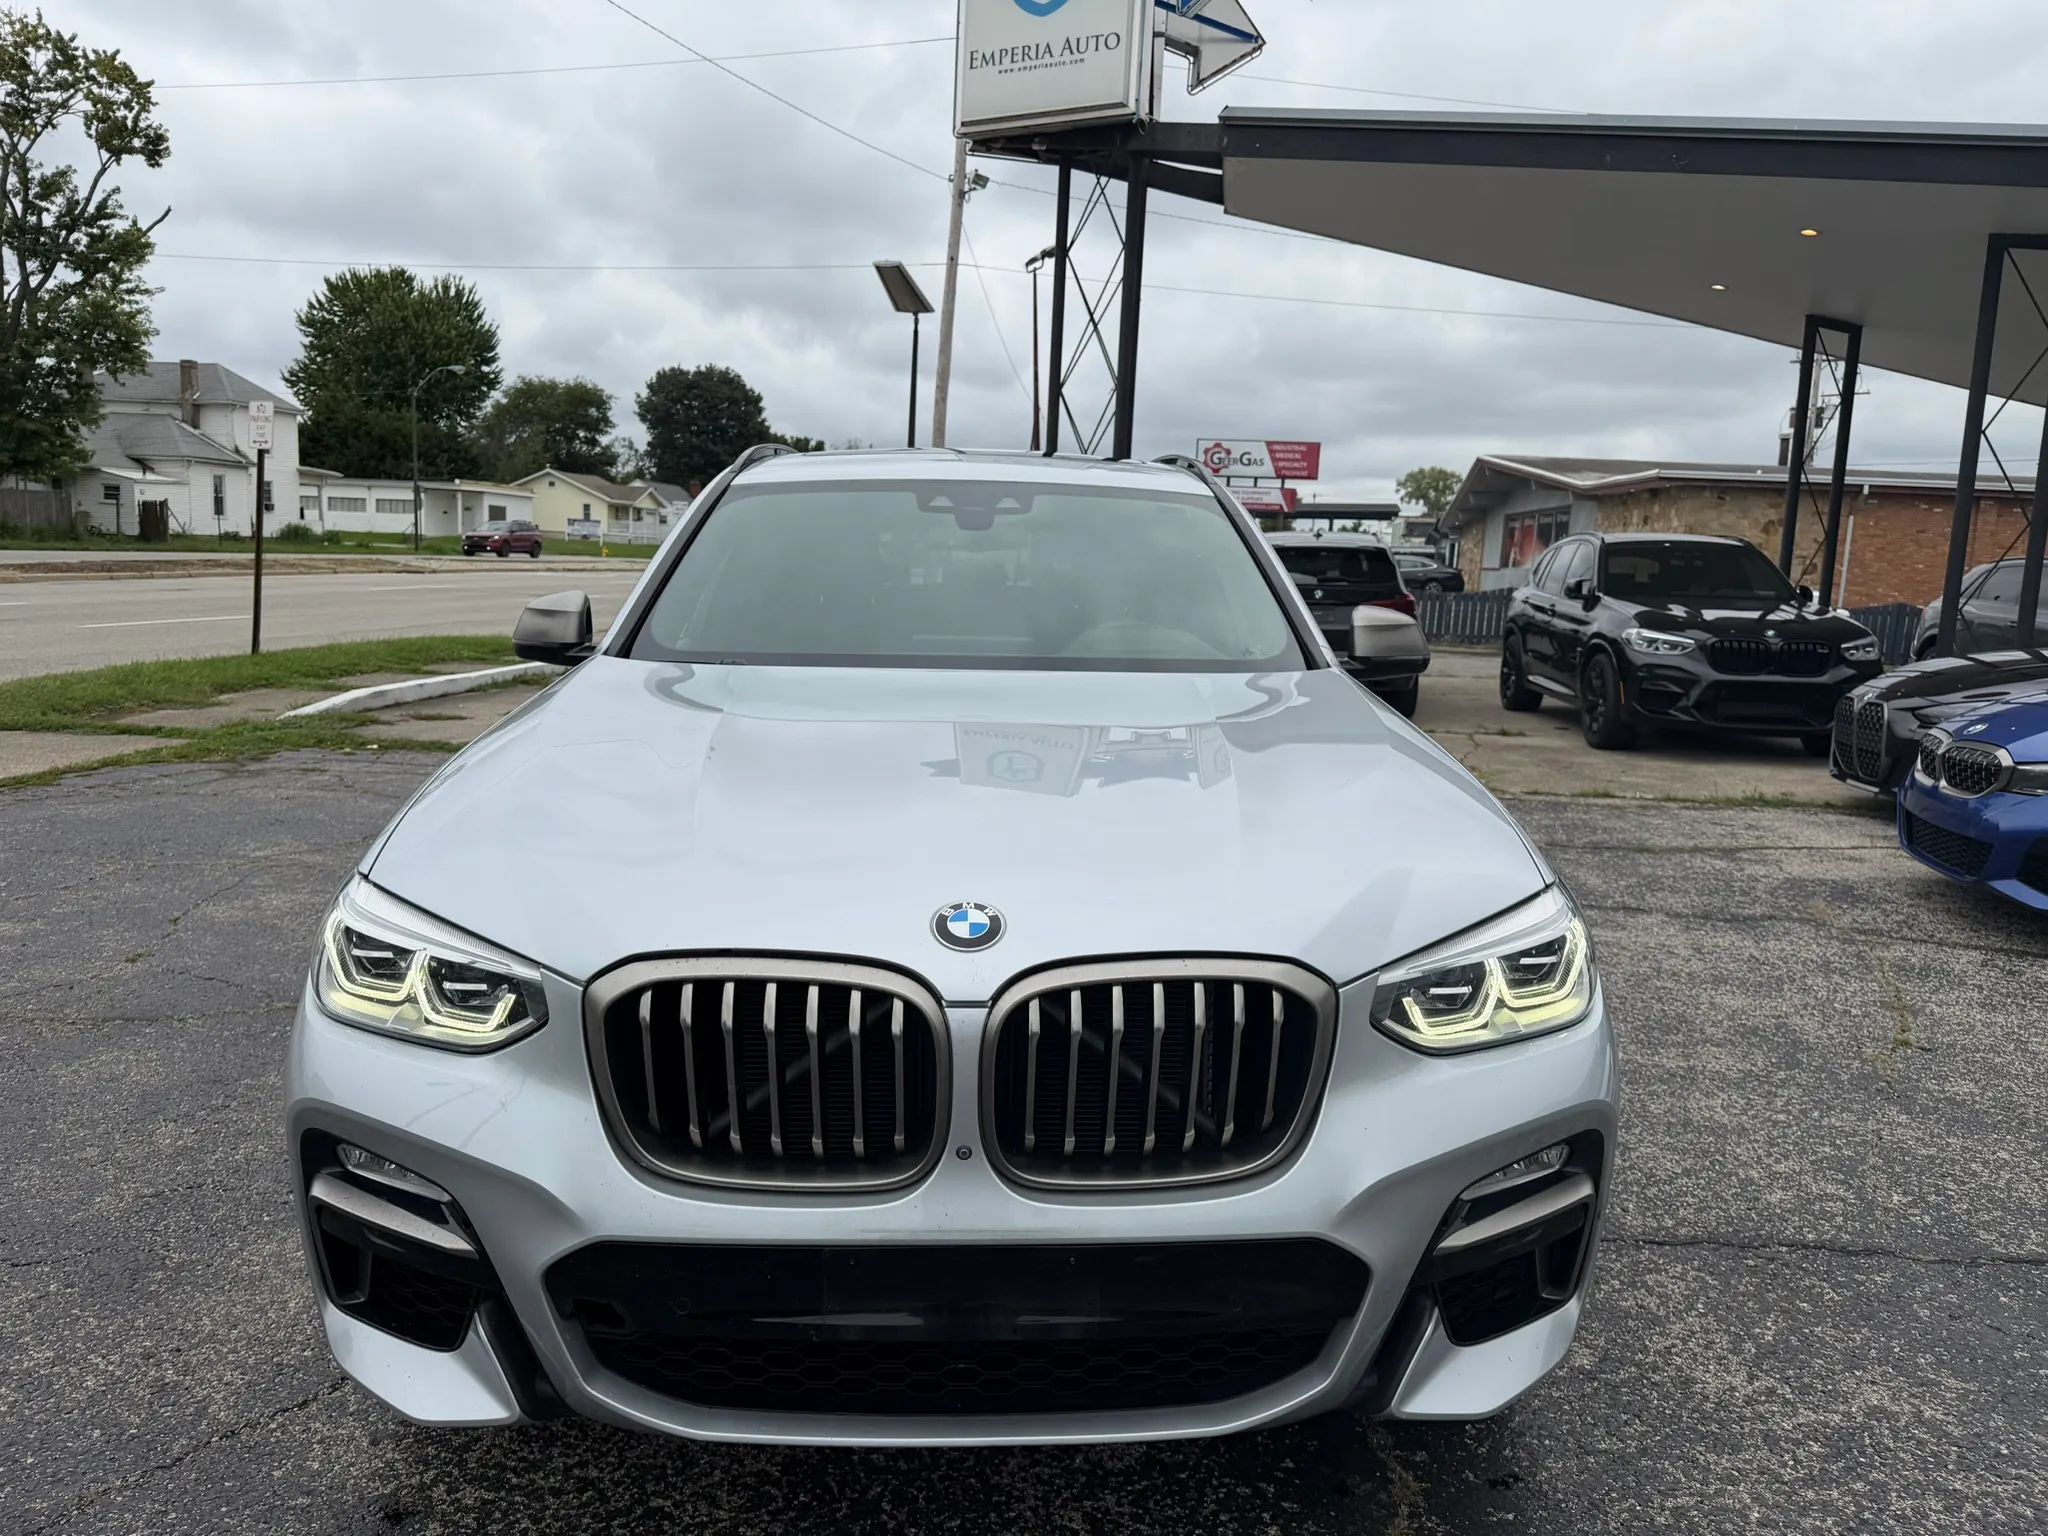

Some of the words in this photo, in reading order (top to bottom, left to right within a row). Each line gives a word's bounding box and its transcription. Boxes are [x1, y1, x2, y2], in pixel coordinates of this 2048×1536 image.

[969, 43, 1053, 70] EMPERIA
[1060, 32, 1121, 56] AUTO
[998, 58, 1085, 74] www.emperiaauto.com
[256, 405, 266, 414] NO
[249, 415, 272, 424] PARKING
[941, 903, 997, 916] BMW
